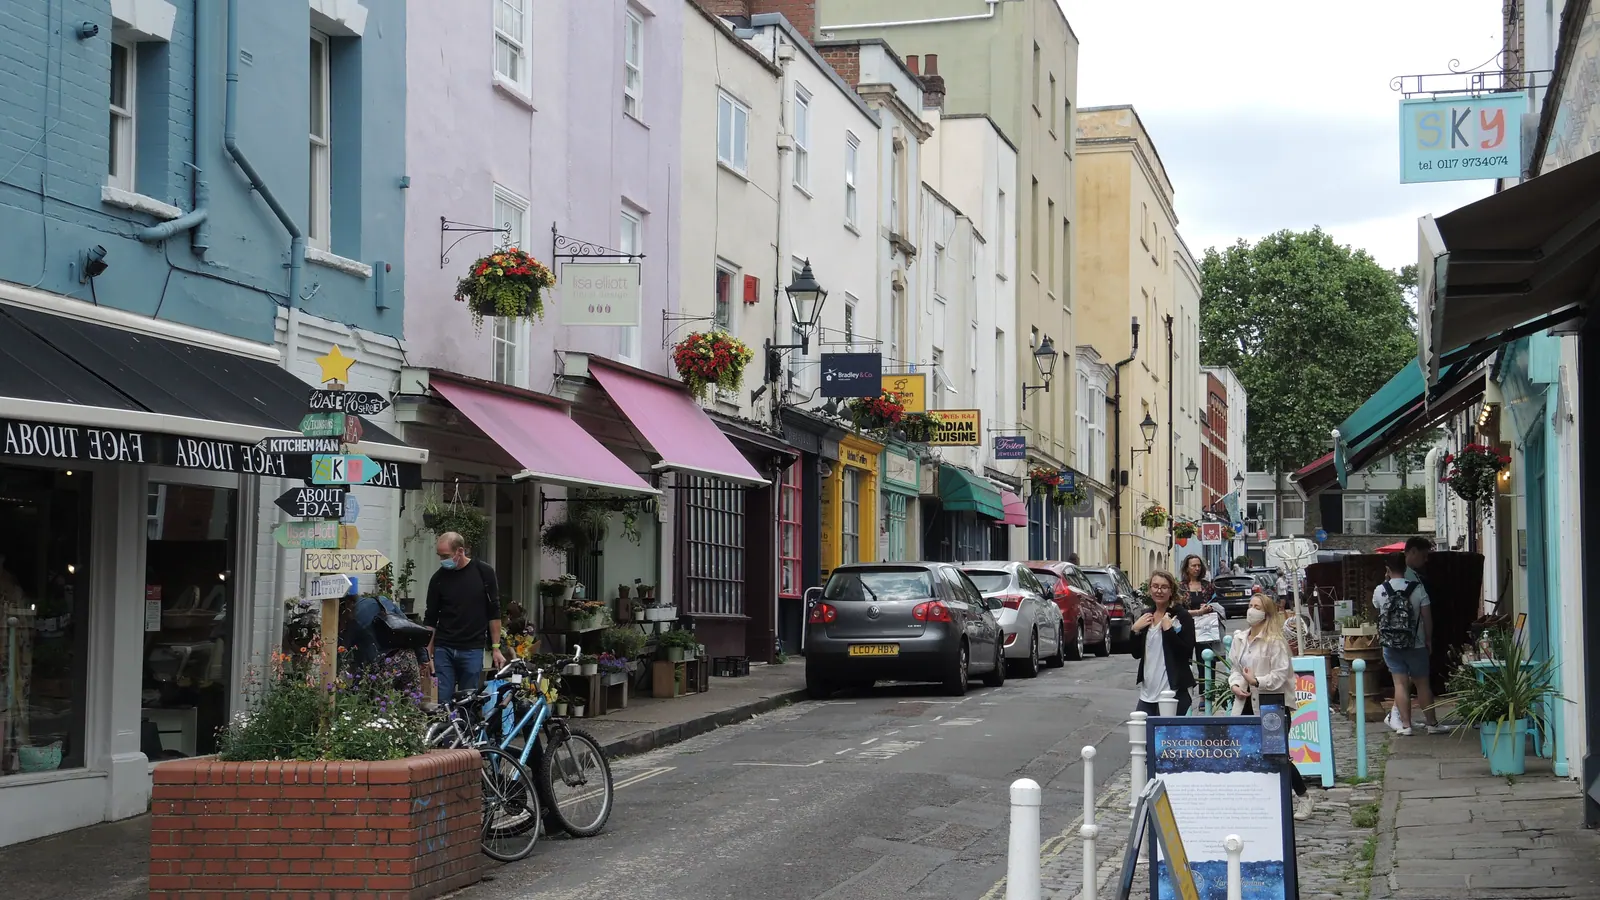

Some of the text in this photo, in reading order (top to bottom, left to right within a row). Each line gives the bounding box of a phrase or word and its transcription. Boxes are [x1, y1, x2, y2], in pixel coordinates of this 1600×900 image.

[1418, 156, 1509, 171] tel 0117 9734074
[838, 371, 859, 380] Bradley
[937, 421, 973, 431] NDIAN
[4, 422, 79, 459] ABOUT
[996, 438, 1025, 450] Foster
[176, 438, 235, 472] ABOUT
[296, 488, 343, 502] ABOUT
[853, 645, 895, 654] LC07 HBX
[1161, 739, 1242, 747] PSYCHOLOGICAL
[1161, 748, 1242, 759] ASTROLOGY
